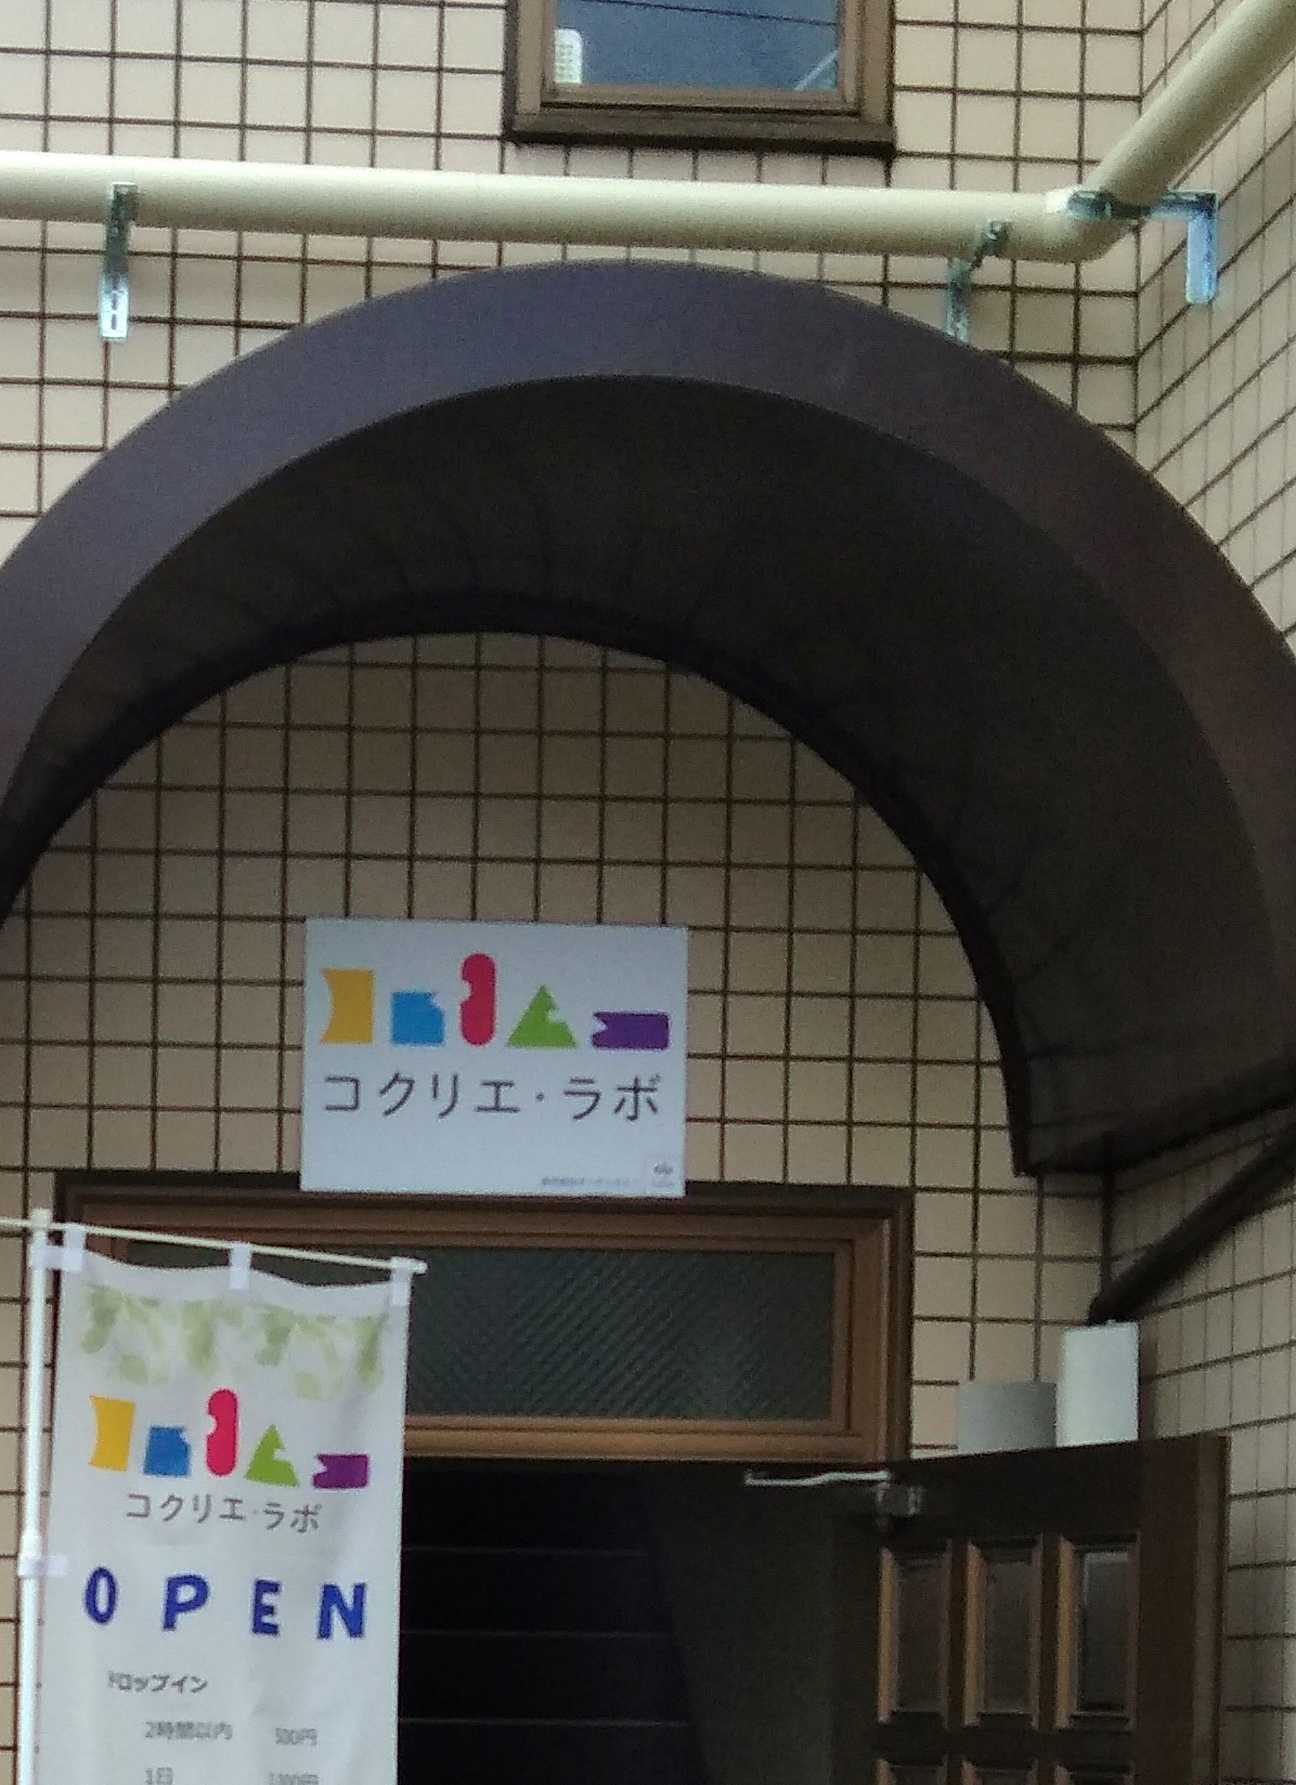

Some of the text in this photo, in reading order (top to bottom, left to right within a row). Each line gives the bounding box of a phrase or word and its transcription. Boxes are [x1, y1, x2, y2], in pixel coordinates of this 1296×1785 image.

[322, 1071, 662, 1122] コクリエ・ラボ
[125, 1493, 323, 1534] コクリエ・ラボ
[84, 1566, 367, 1640] OPEN
